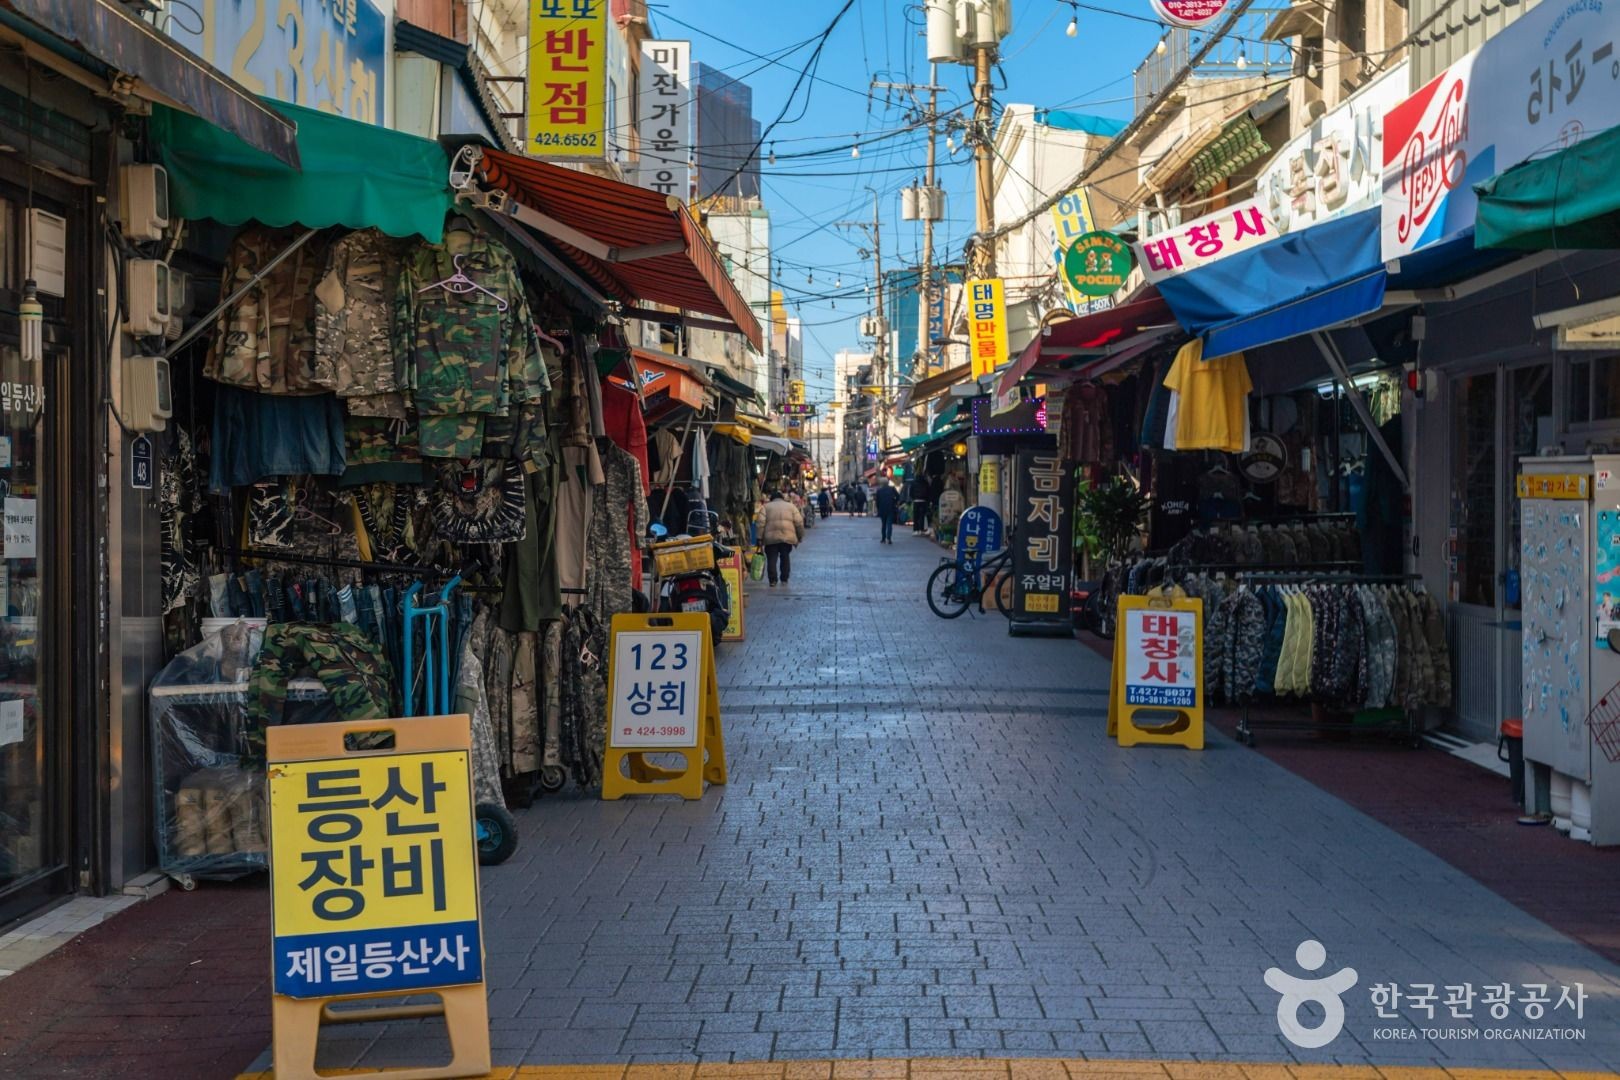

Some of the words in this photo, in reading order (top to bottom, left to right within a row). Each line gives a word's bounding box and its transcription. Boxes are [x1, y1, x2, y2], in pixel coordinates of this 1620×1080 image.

[543, 28, 594, 125] 반점
[535, 133, 597, 147] 424.6562
[1075, 275, 1121, 285] POCHA
[1, 382, 46, 414] 일등산사
[137, 462, 147, 481] 48
[1027, 456, 1067, 572] 금자리
[1021, 574, 1065, 591] 쥬얼리
[631, 643, 688, 671] 123
[1141, 615, 1180, 684] 태창사
[627, 681, 686, 715] 상회
[636, 727, 686, 736] 424-3998
[298, 762, 447, 843] 등산
[298, 839, 447, 921] 장비
[286, 935, 470, 984] 제일등산사
